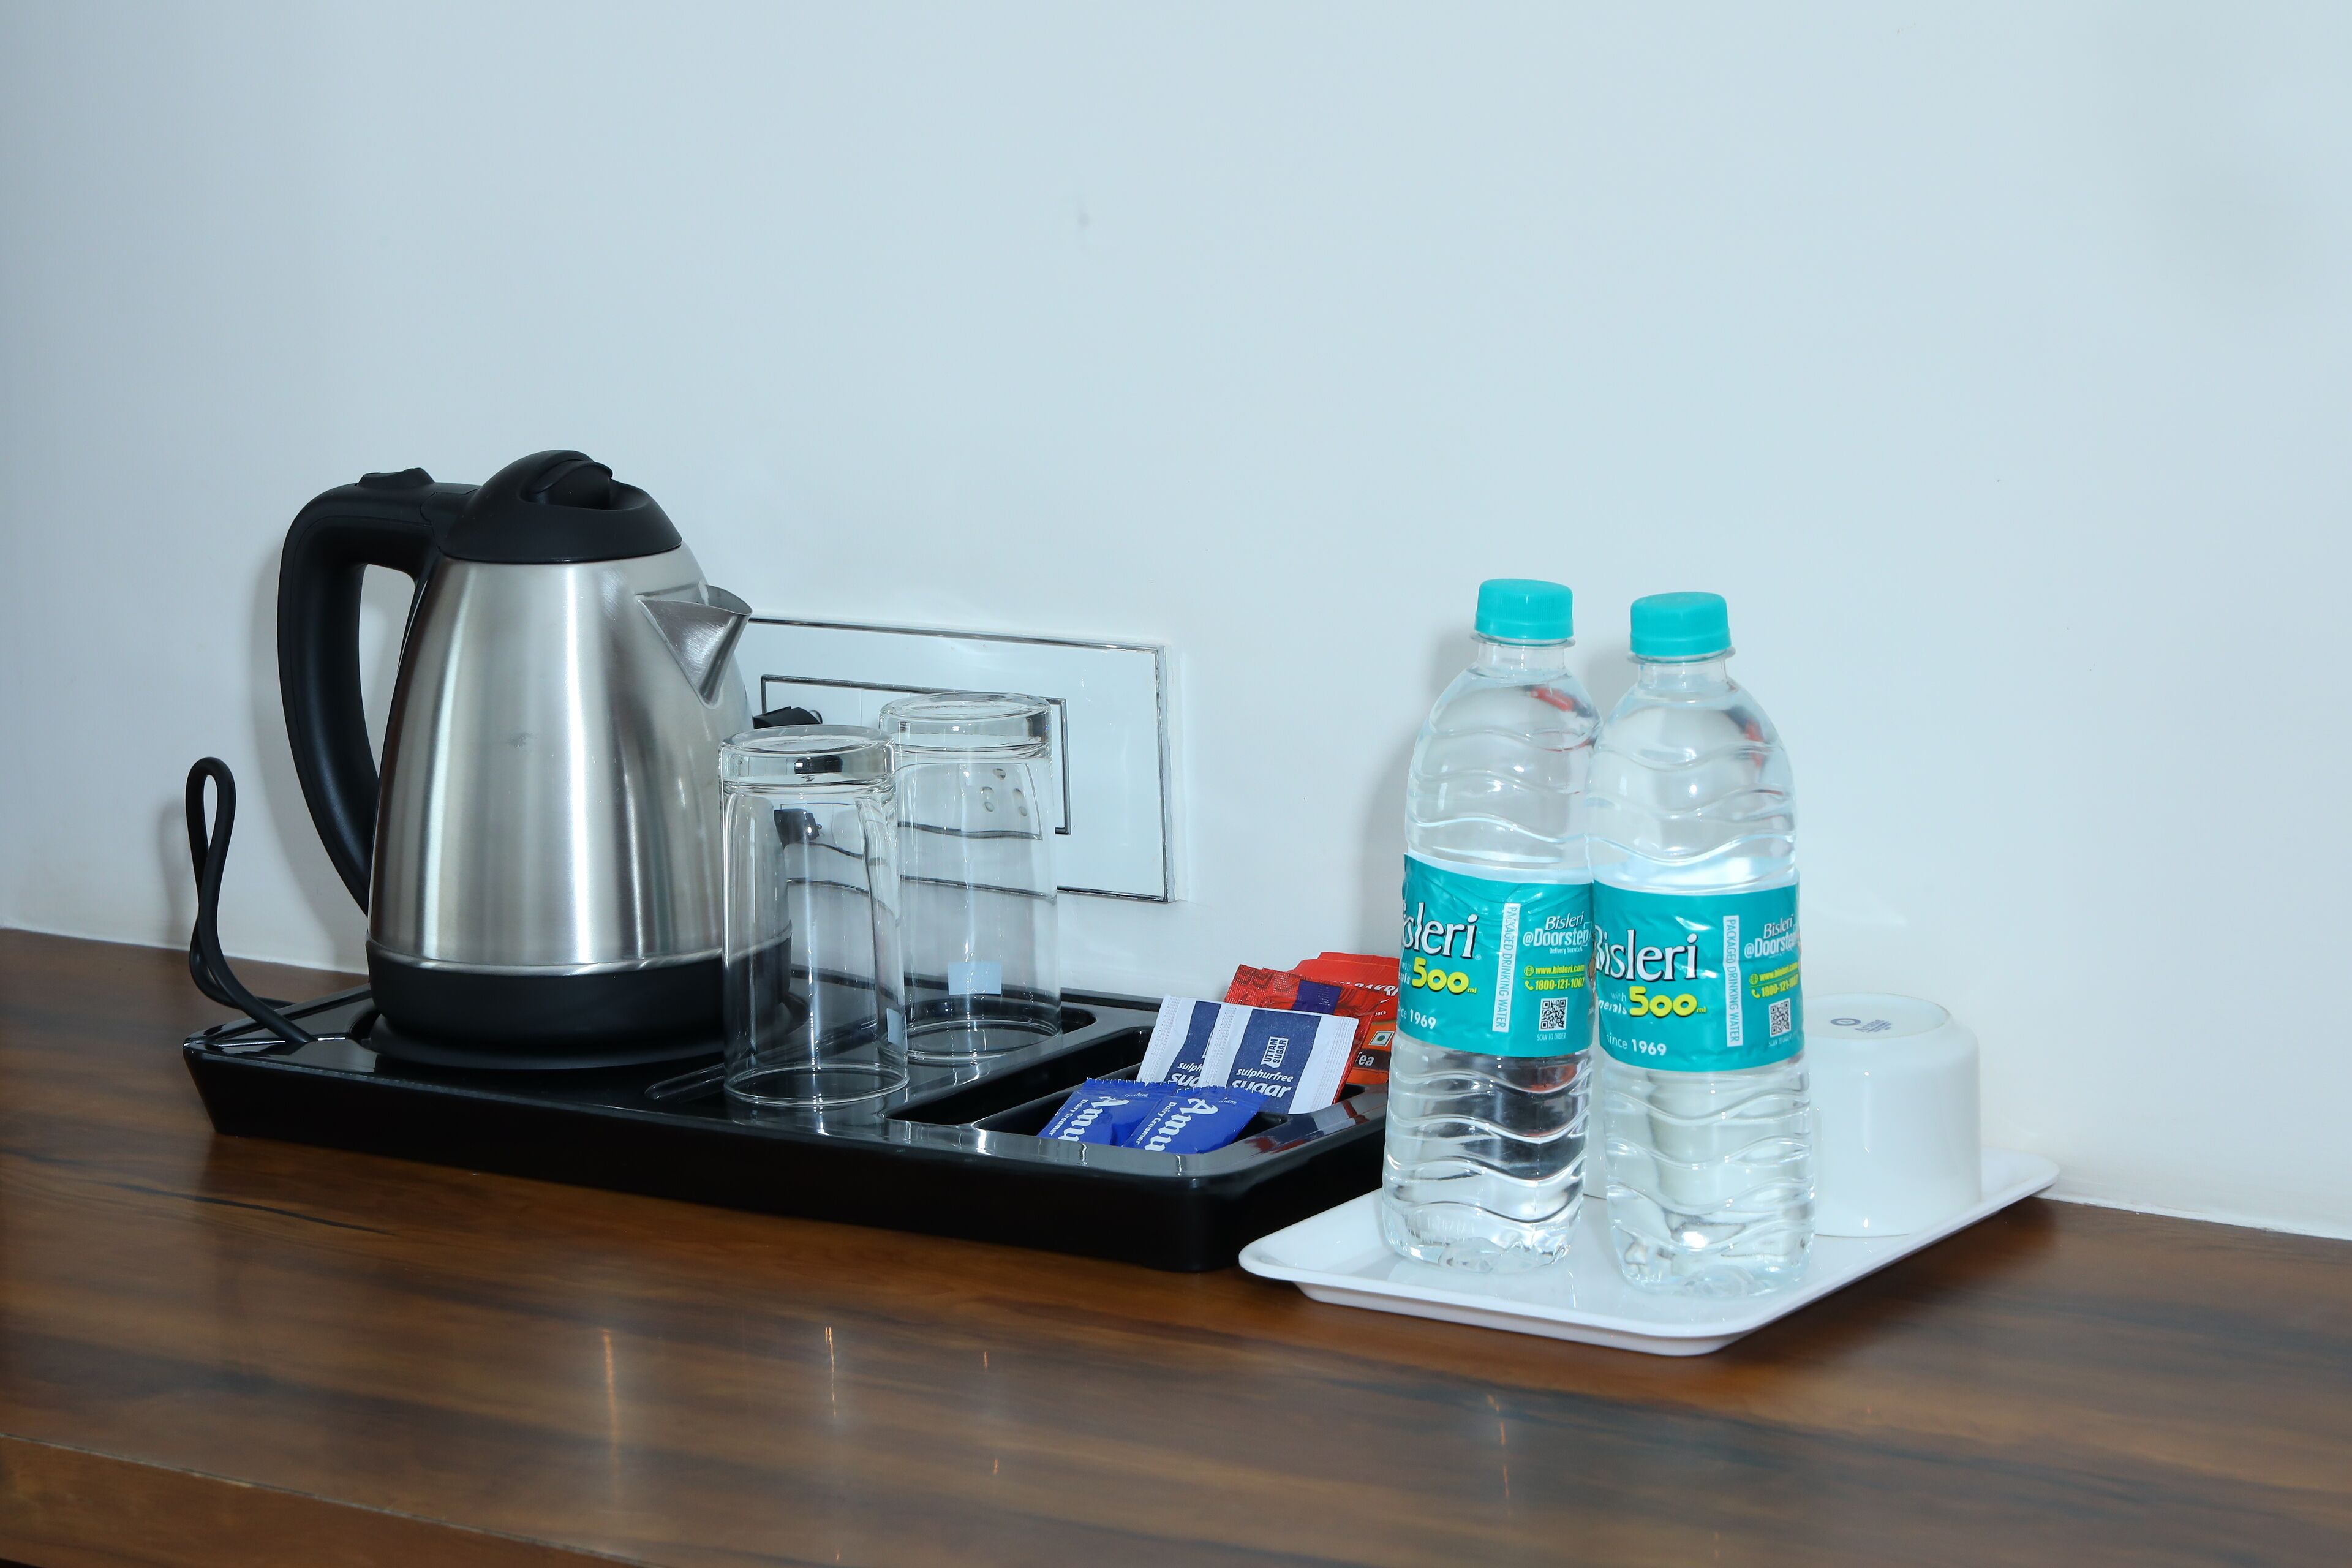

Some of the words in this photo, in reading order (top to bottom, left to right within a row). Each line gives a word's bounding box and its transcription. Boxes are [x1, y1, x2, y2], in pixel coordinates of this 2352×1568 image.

[1504, 907, 1517, 950] PACKAGED
[1545, 911, 1585, 930] Bisleri
[1763, 914, 1793, 940] Bisleri
[1523, 927, 1589, 948] @Doorstep
[1726, 919, 1736, 963] PACKAGED
[1411, 956, 1469, 995] 500
[1499, 952, 1512, 997] DRINKING
[1536, 977, 1585, 990] 1800-121-1007
[1727, 966, 1739, 1011] DRINKING
[1496, 999, 1509, 1028] WATER
[1598, 999, 1627, 1015] nerals
[1629, 986, 1698, 1018] 500
[1409, 1009, 1437, 1030] 1969
[1729, 1012, 1740, 1042] WATER
[1263, 1038, 1279, 1063] UTTAM
[1272, 1039, 1287, 1064] SUGAR
[1631, 1038, 1667, 1056] 1969
[1236, 1068, 1294, 1082] sulphurfree
[1070, 1099, 1089, 1112] Dairy
[1157, 1102, 1177, 1117] Dairy
[1049, 1111, 1074, 1136] Creamer
[1135, 1117, 1161, 1145] Creamer
[1144, 1098, 1219, 1152] Amu
